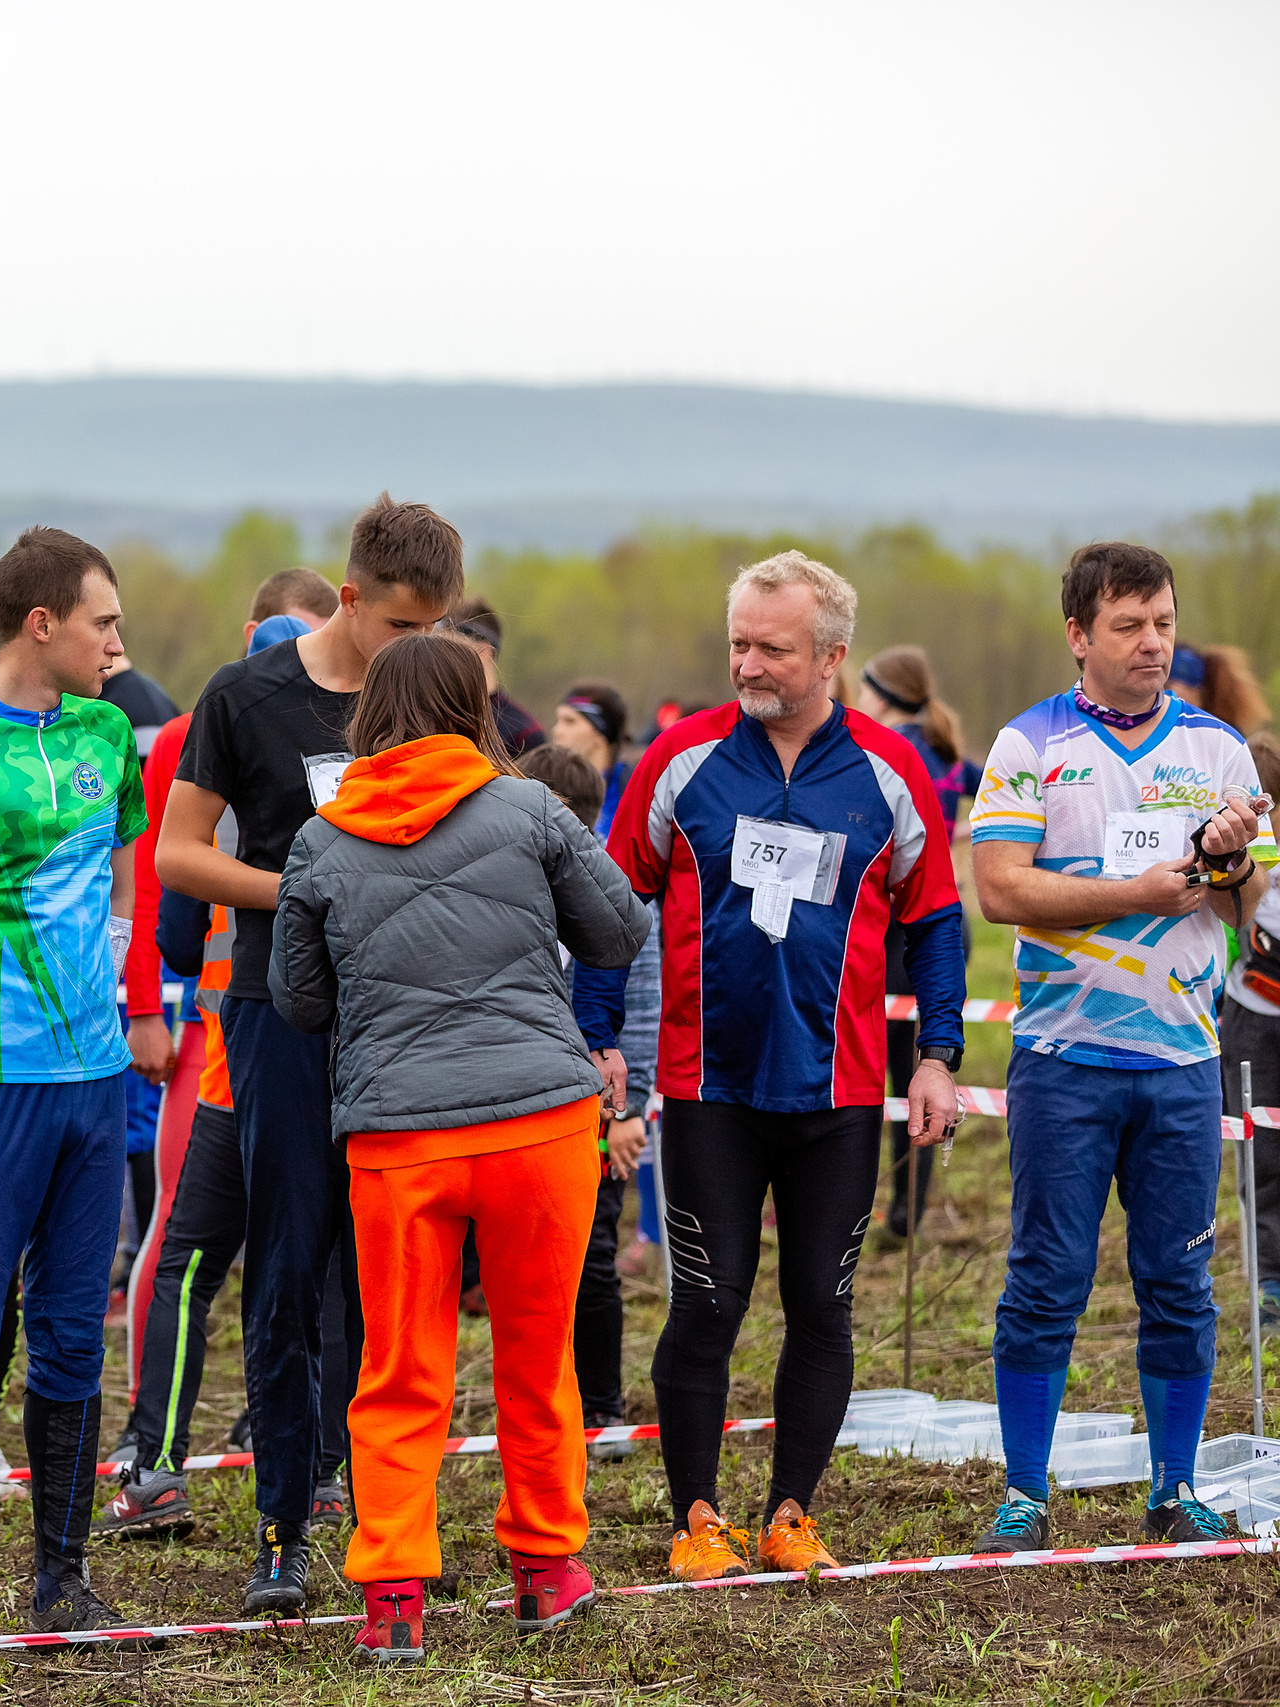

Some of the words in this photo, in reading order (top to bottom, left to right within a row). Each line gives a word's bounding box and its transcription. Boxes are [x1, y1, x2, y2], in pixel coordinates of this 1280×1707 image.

[1152, 763, 1211, 785] WMOC
[1161, 782, 1208, 803] 2020
[1122, 830, 1160, 849] 705
[750, 841, 788, 865] 757
